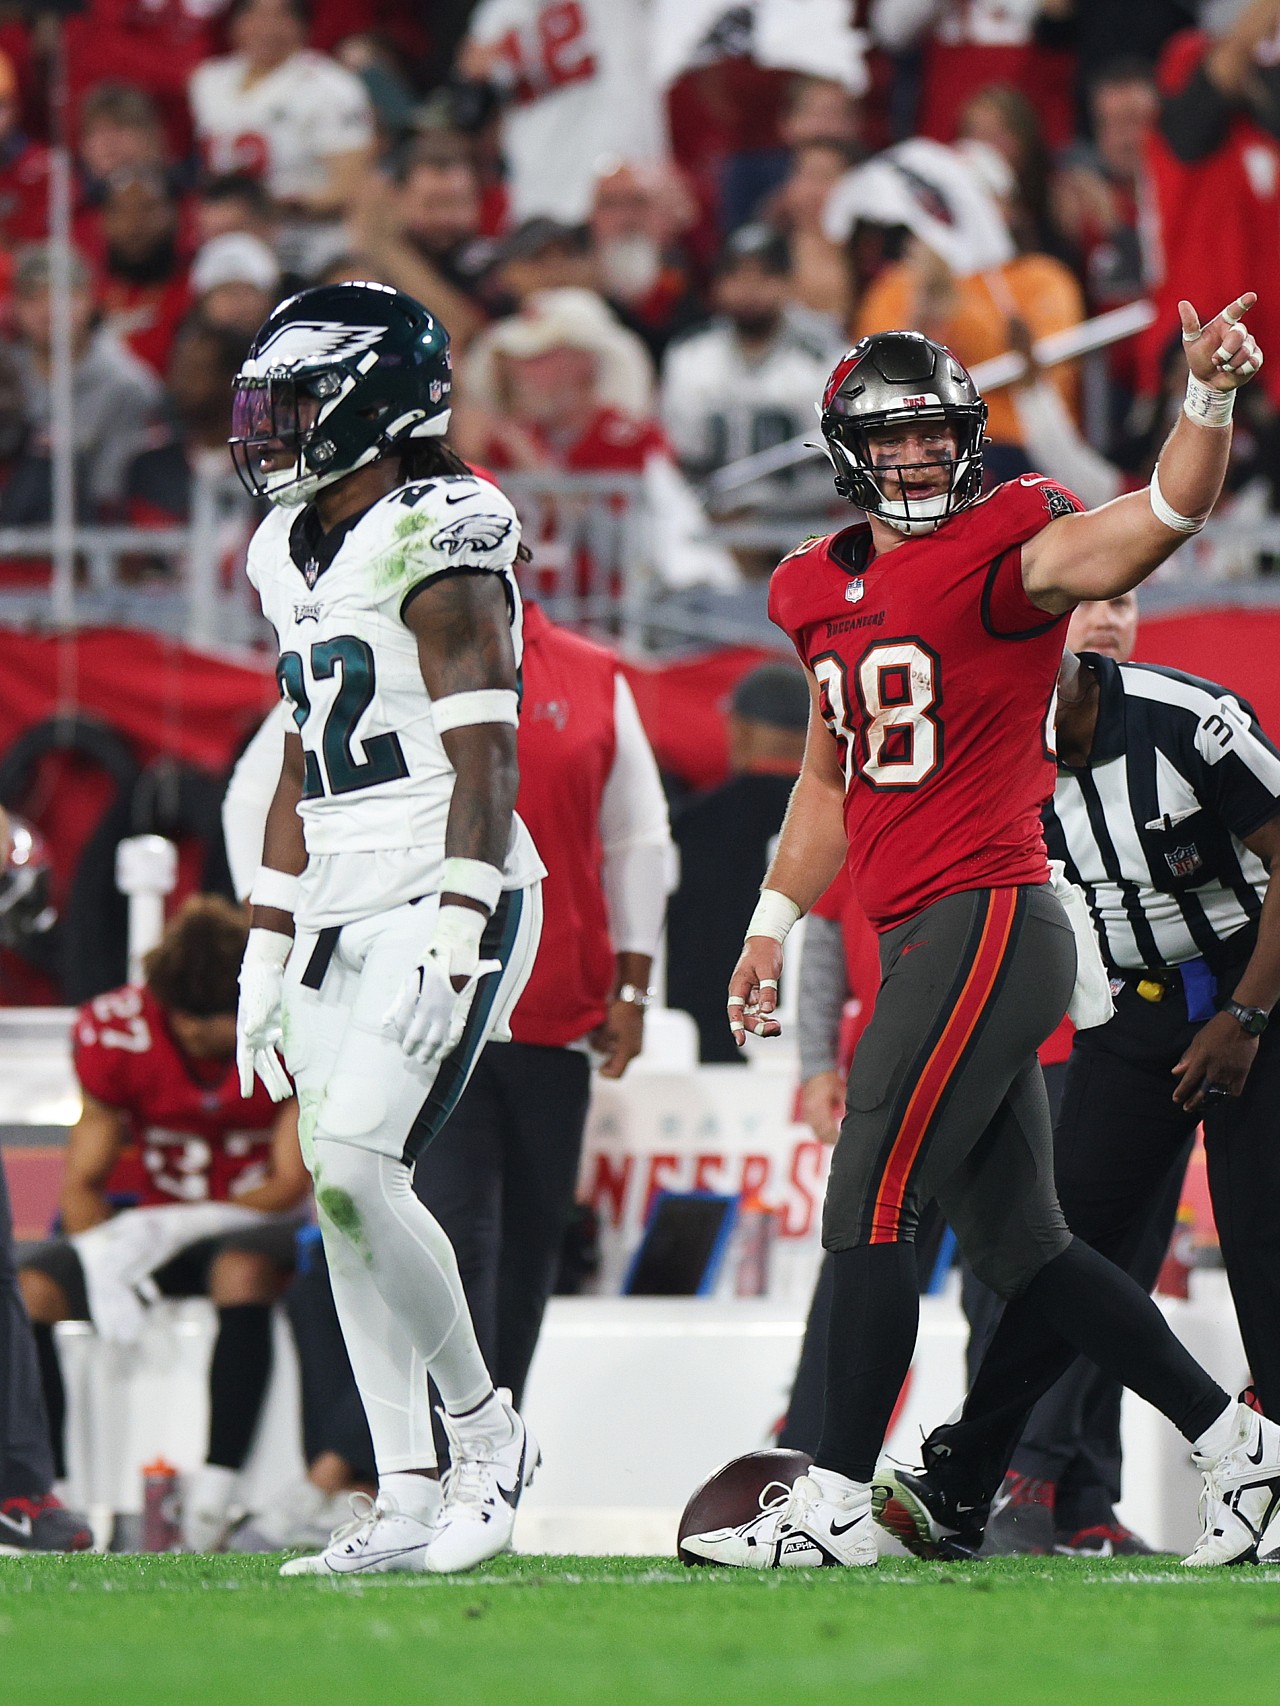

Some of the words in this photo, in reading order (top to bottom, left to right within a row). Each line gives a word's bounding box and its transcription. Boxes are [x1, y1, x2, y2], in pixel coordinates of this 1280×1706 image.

[502, 2, 598, 107] 12
[826, 610, 886, 639] BUCCANEERS
[276, 635, 411, 800] 22
[1202, 703, 1244, 748] 31
[785, 1541, 817, 1553] ALPHA
